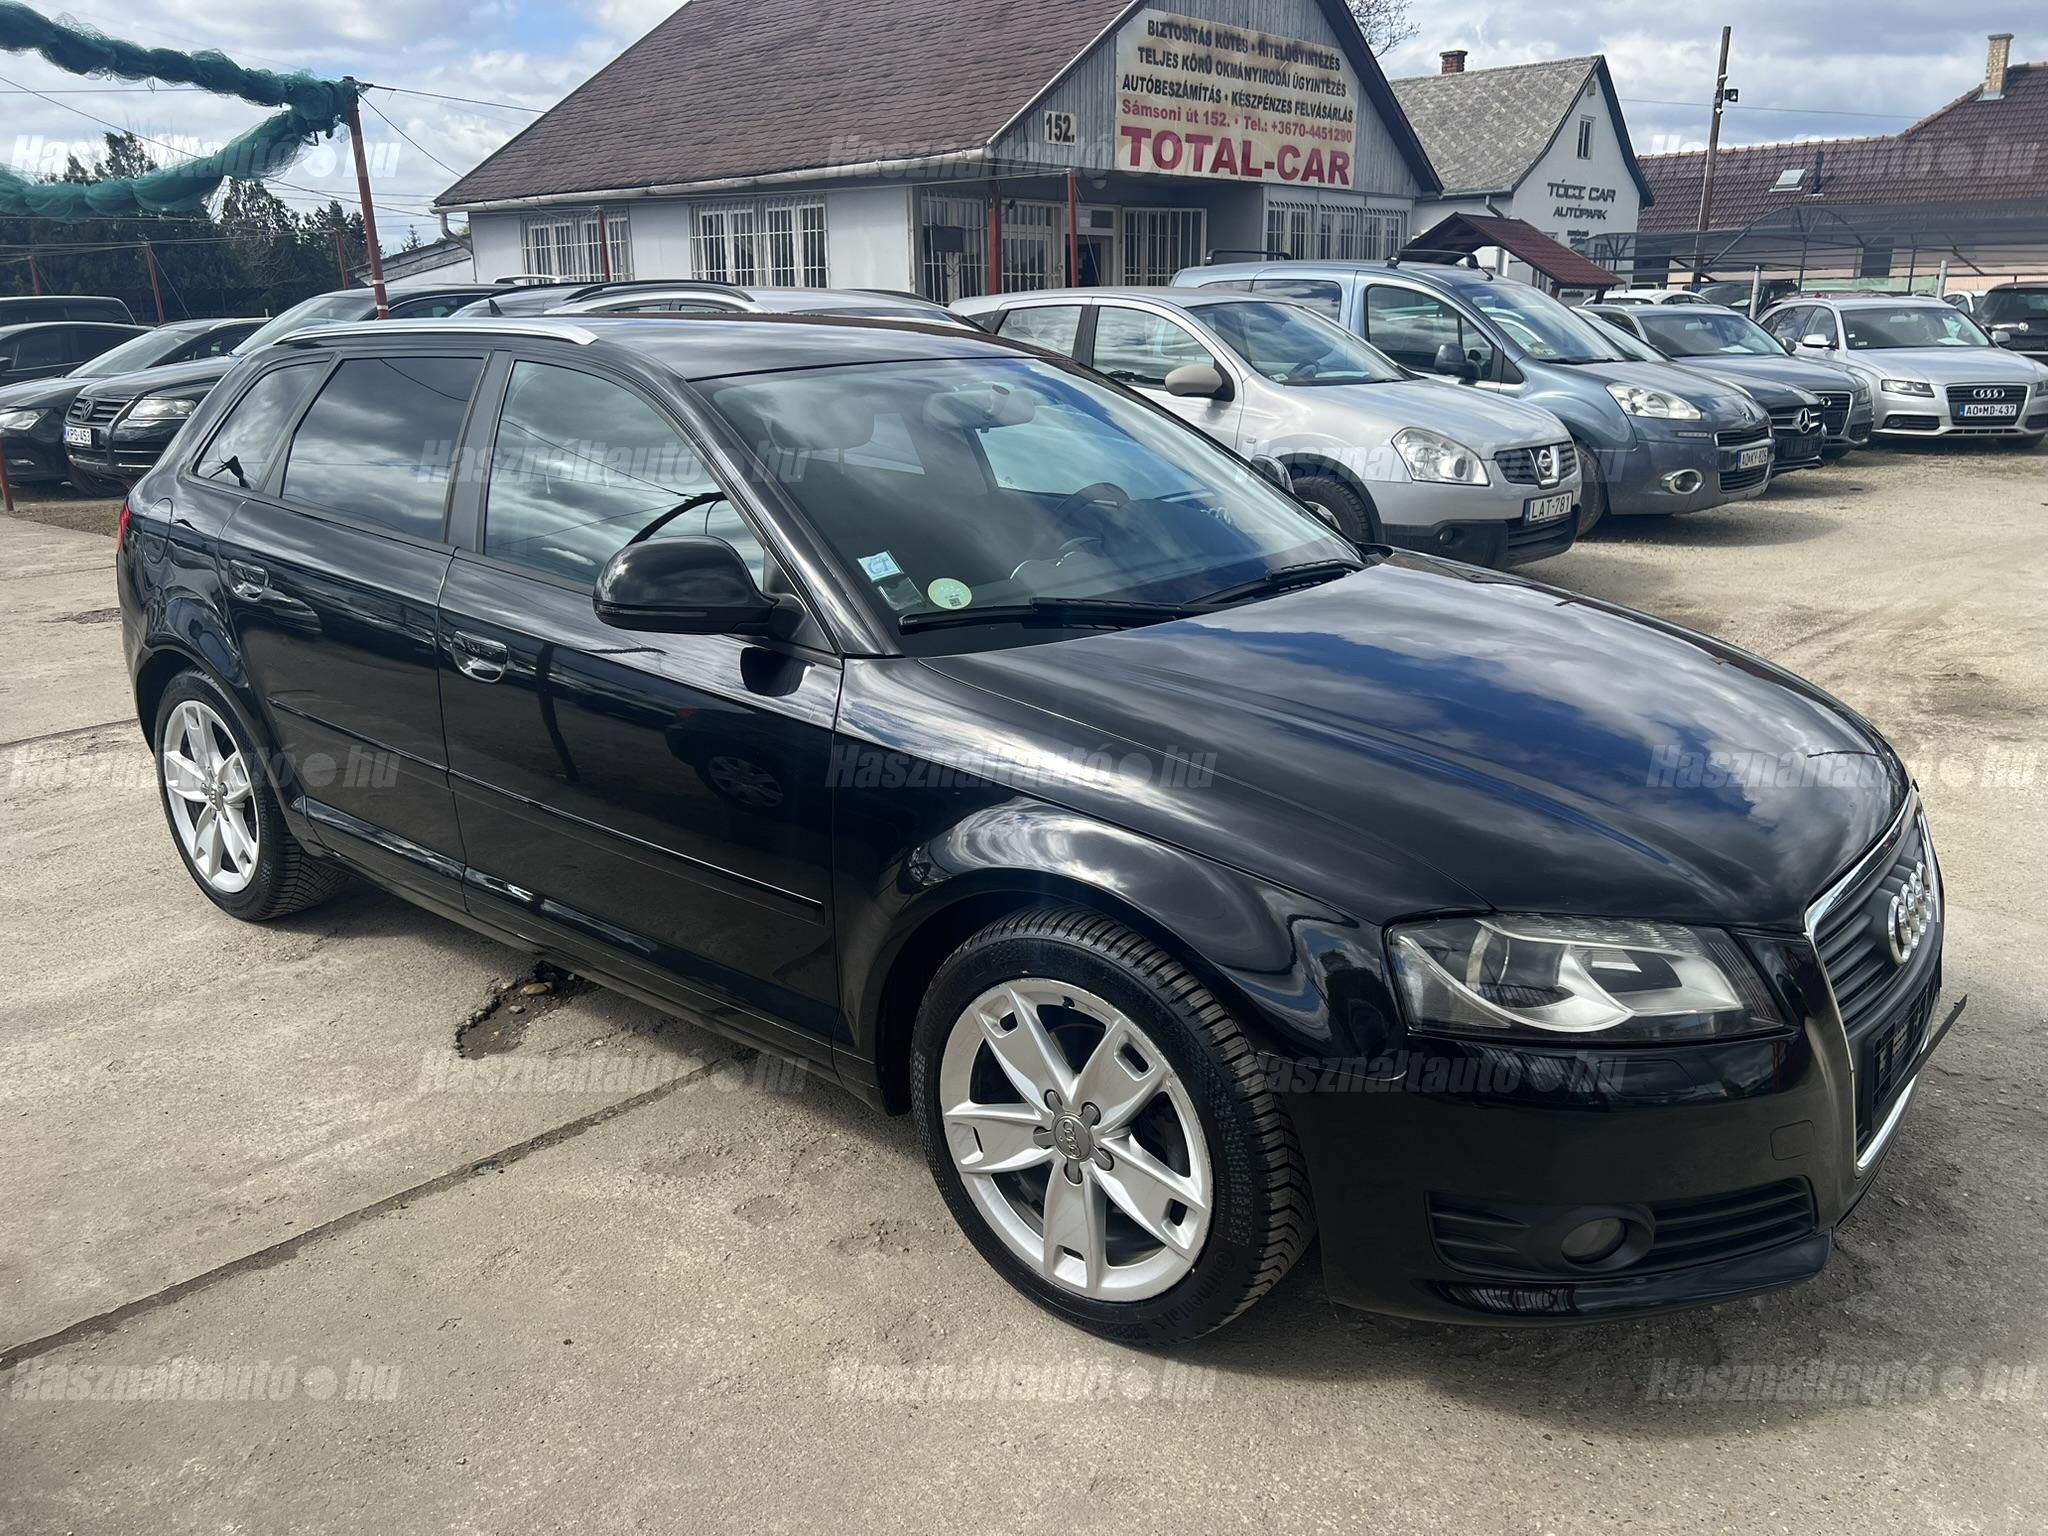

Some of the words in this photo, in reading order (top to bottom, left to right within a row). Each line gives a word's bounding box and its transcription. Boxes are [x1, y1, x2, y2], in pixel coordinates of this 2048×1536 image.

[1138, 46, 1178, 69] TELJES
[1215, 59, 1290, 88] OKMÁNYIRODAI
[1122, 74, 1221, 104] AUTÓBESZÁMÍTÁS
[1231, 90, 1292, 114] KÉSZPÉNZES
[1295, 101, 1353, 123] FELVÁSÁRLÁS
[1122, 99, 1182, 121] Sámsoni
[1186, 108, 1198, 124] út
[1203, 110, 1230, 127] 152.
[1046, 113, 1075, 143] 152.
[1121, 125, 1350, 186] TOTAL-CAR
[1588, 187, 1616, 203] CAR
[1553, 204, 1608, 220] AUTÓPARK
[1531, 495, 1570, 518] LAT-781
